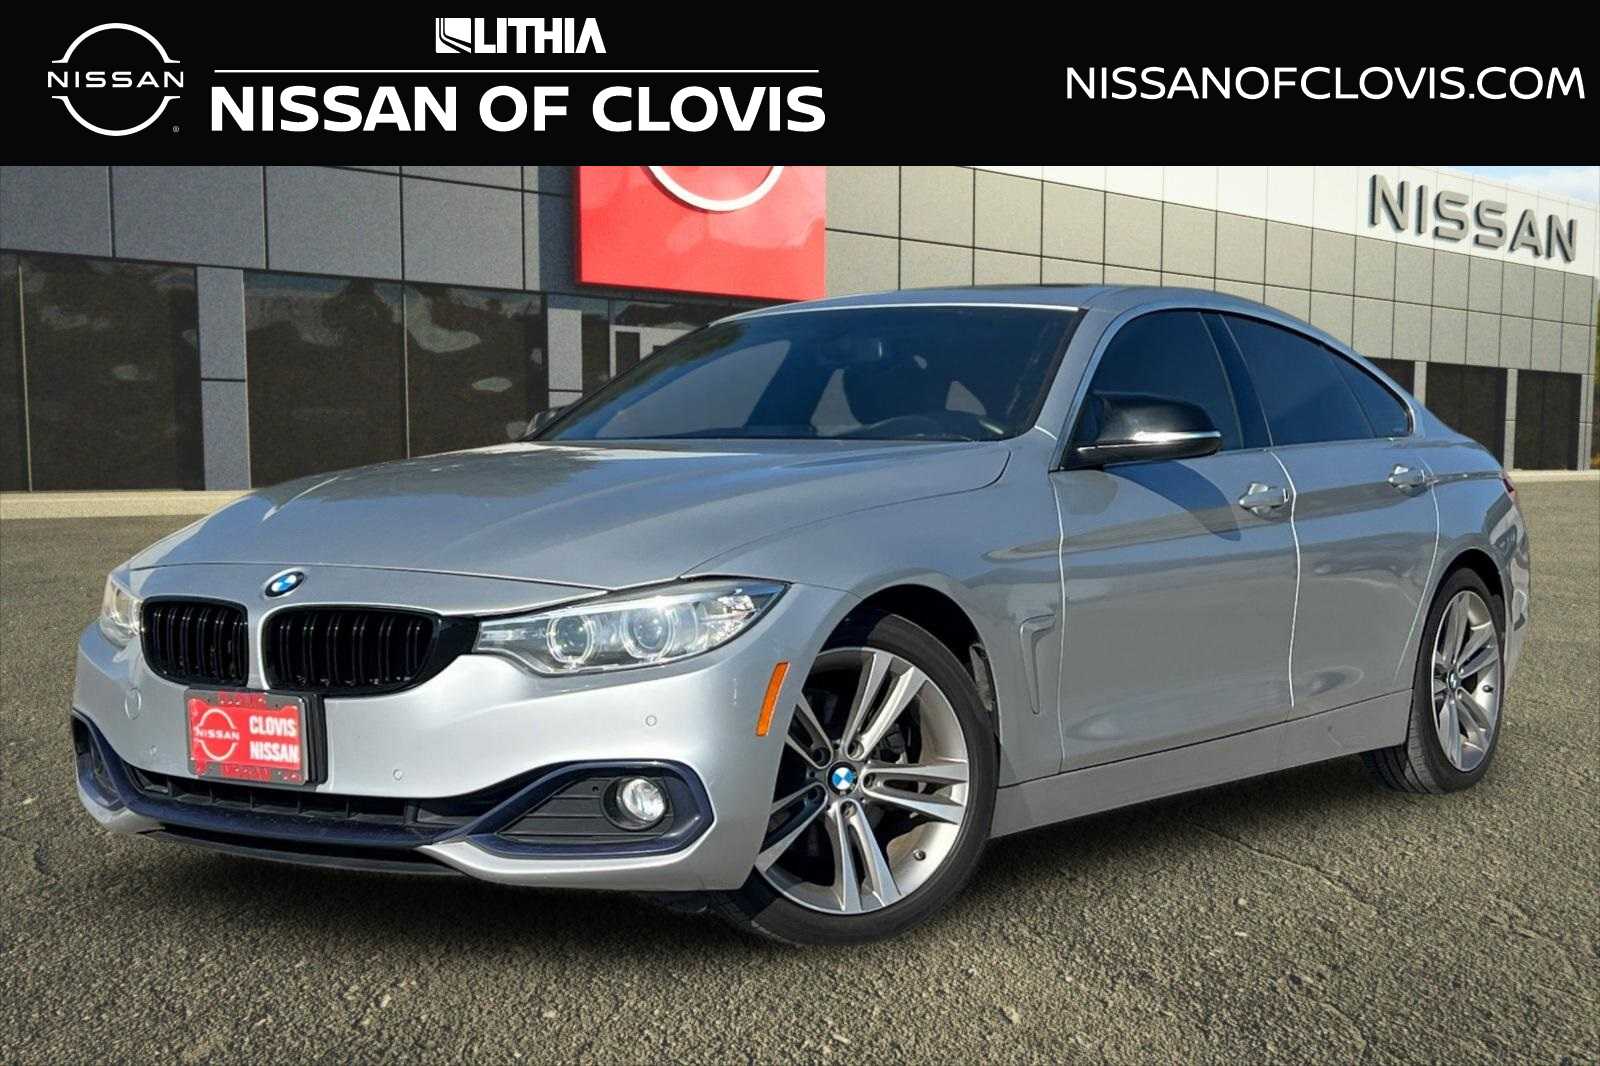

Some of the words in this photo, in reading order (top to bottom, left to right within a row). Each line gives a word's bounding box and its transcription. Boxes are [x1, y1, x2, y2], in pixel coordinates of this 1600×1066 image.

[1368, 174, 1577, 264] NISSAN
[194, 726, 240, 740] NISSAN
[249, 715, 297, 737] CLOVIS
[249, 740, 300, 763] NISSAN
